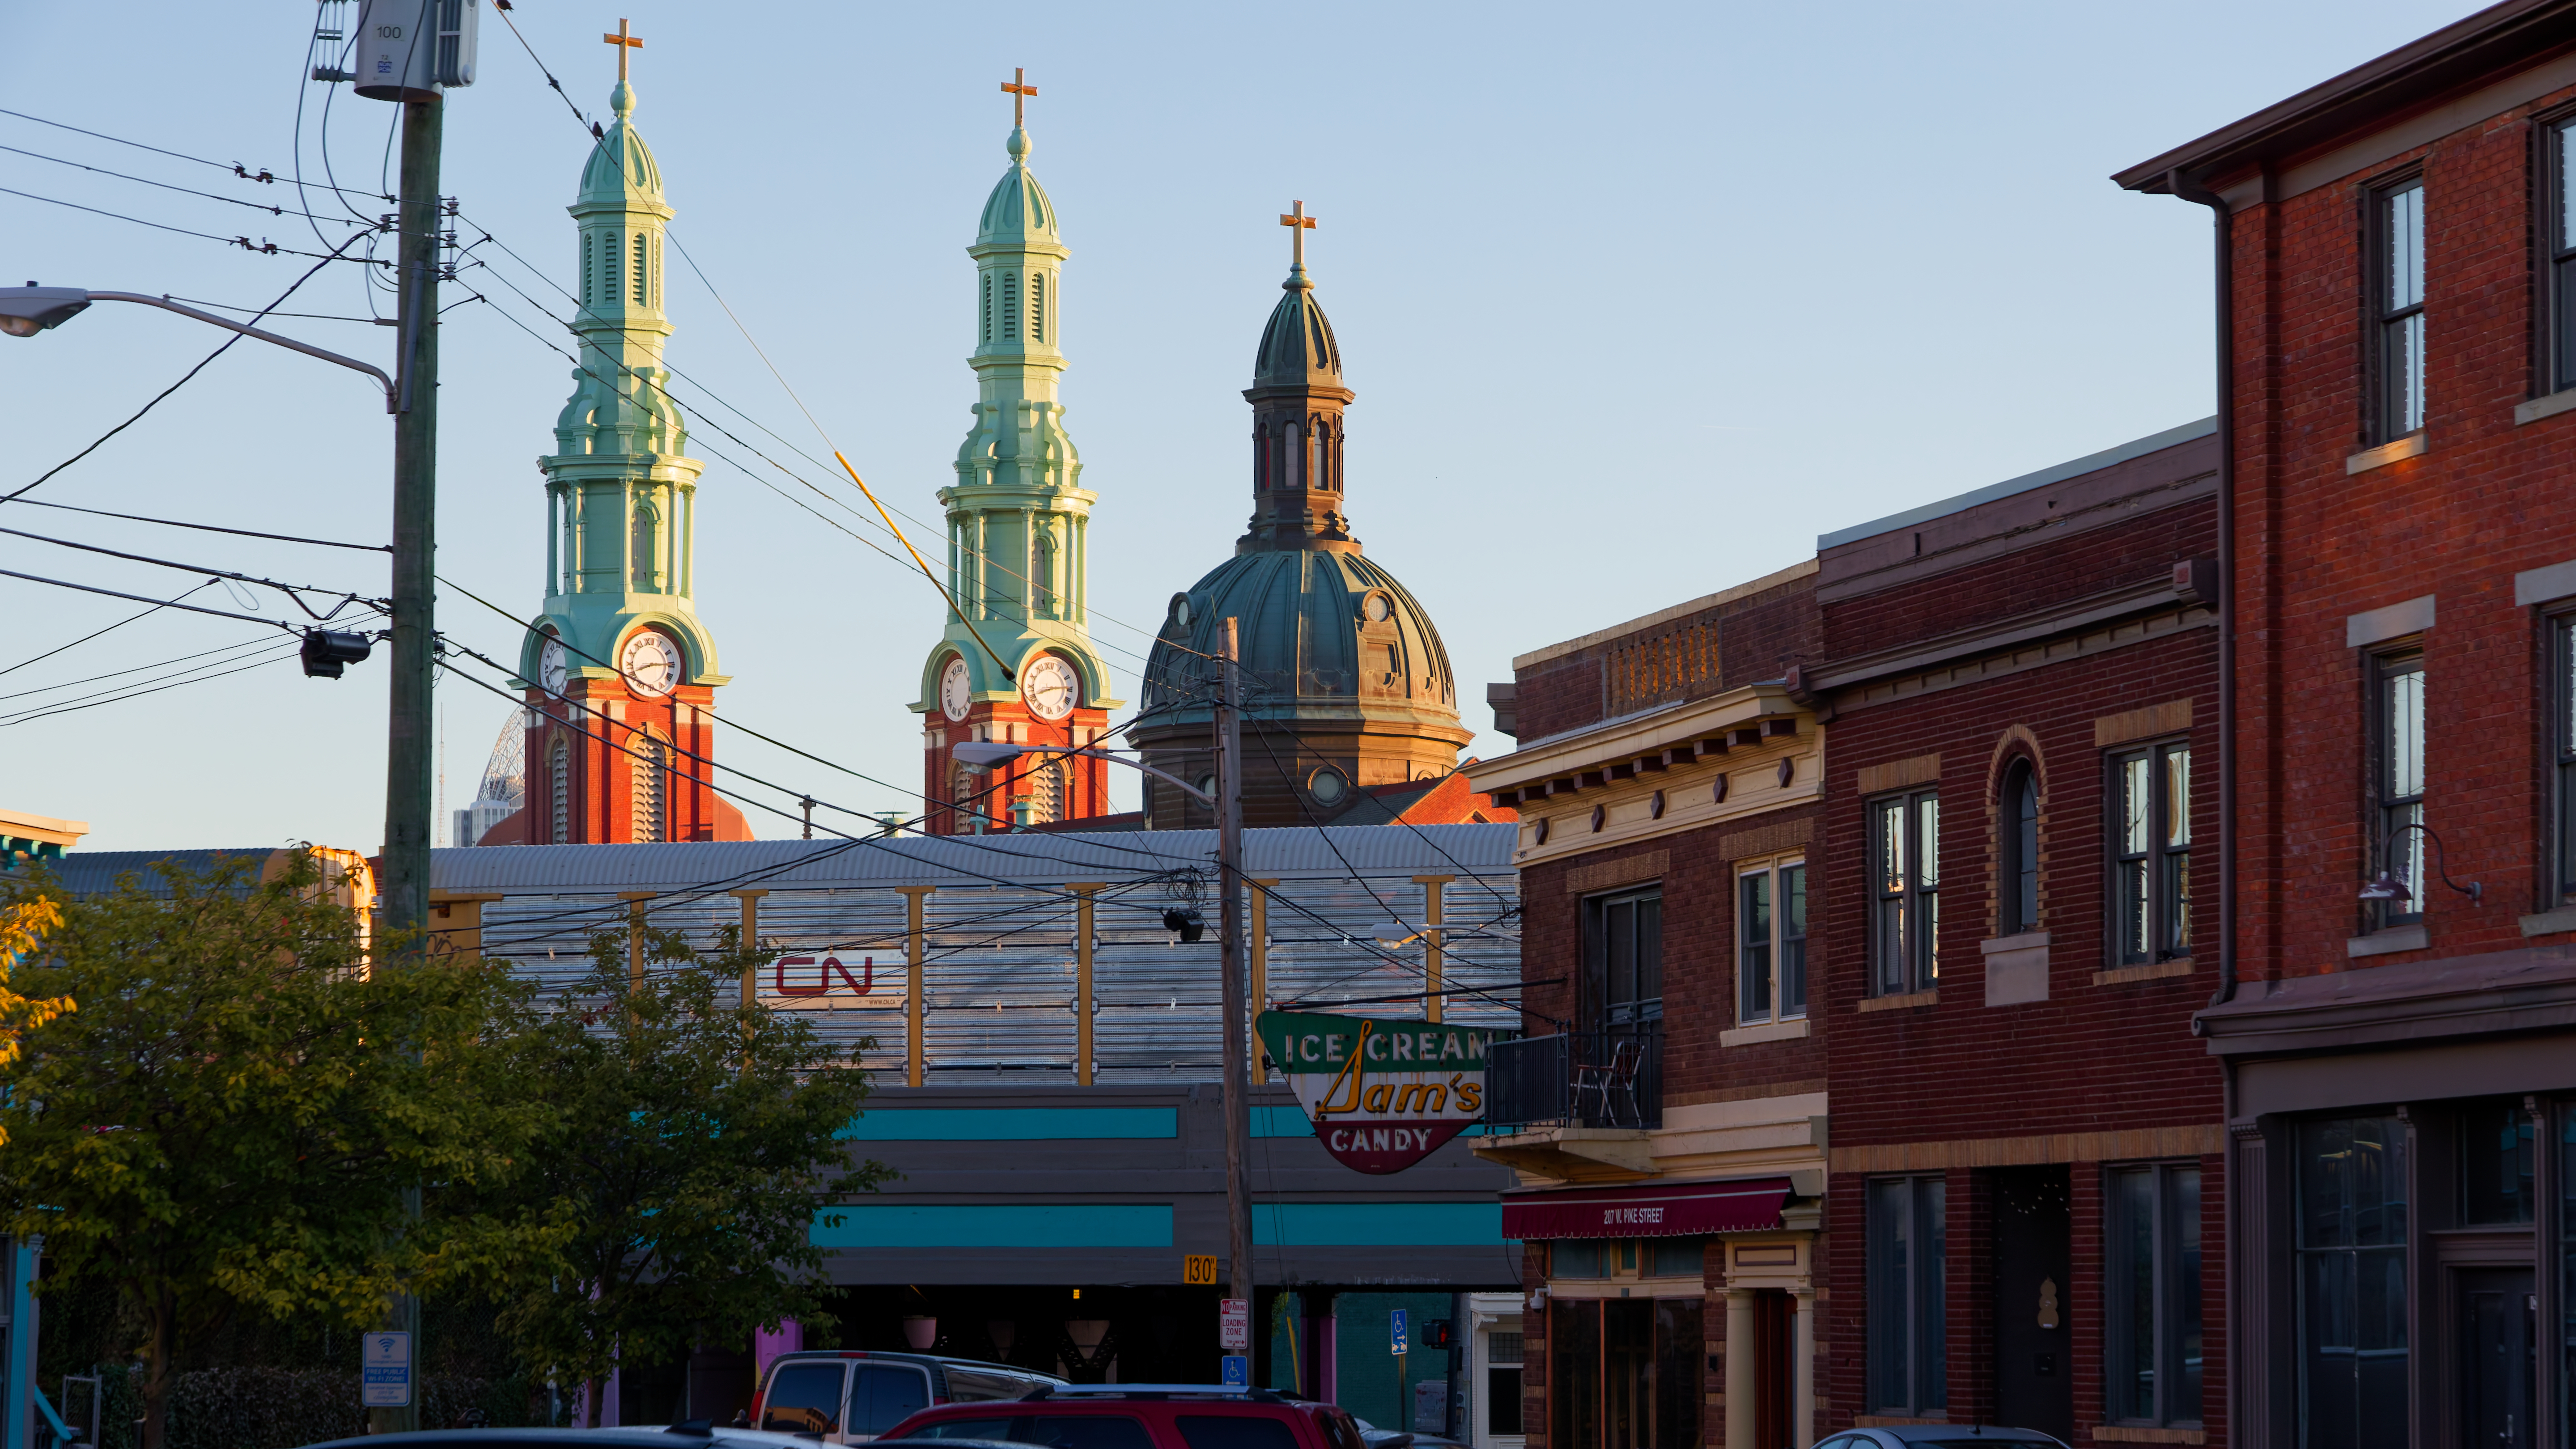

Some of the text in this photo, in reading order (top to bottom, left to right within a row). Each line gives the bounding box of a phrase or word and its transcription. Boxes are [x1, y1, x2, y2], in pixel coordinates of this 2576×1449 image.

[377, 26, 401, 38] 100
[777, 957, 872, 996] CN
[1286, 1032, 1492, 1063] ICE CREAM
[1314, 1020, 1481, 1119] Sam's
[1331, 1129, 1432, 1152] CANDY
[1604, 1208, 1664, 1224] 207 W. PIKE STREET
[1222, 1303, 1229, 1312] NO
[1222, 1319, 1245, 1327] LOADING
